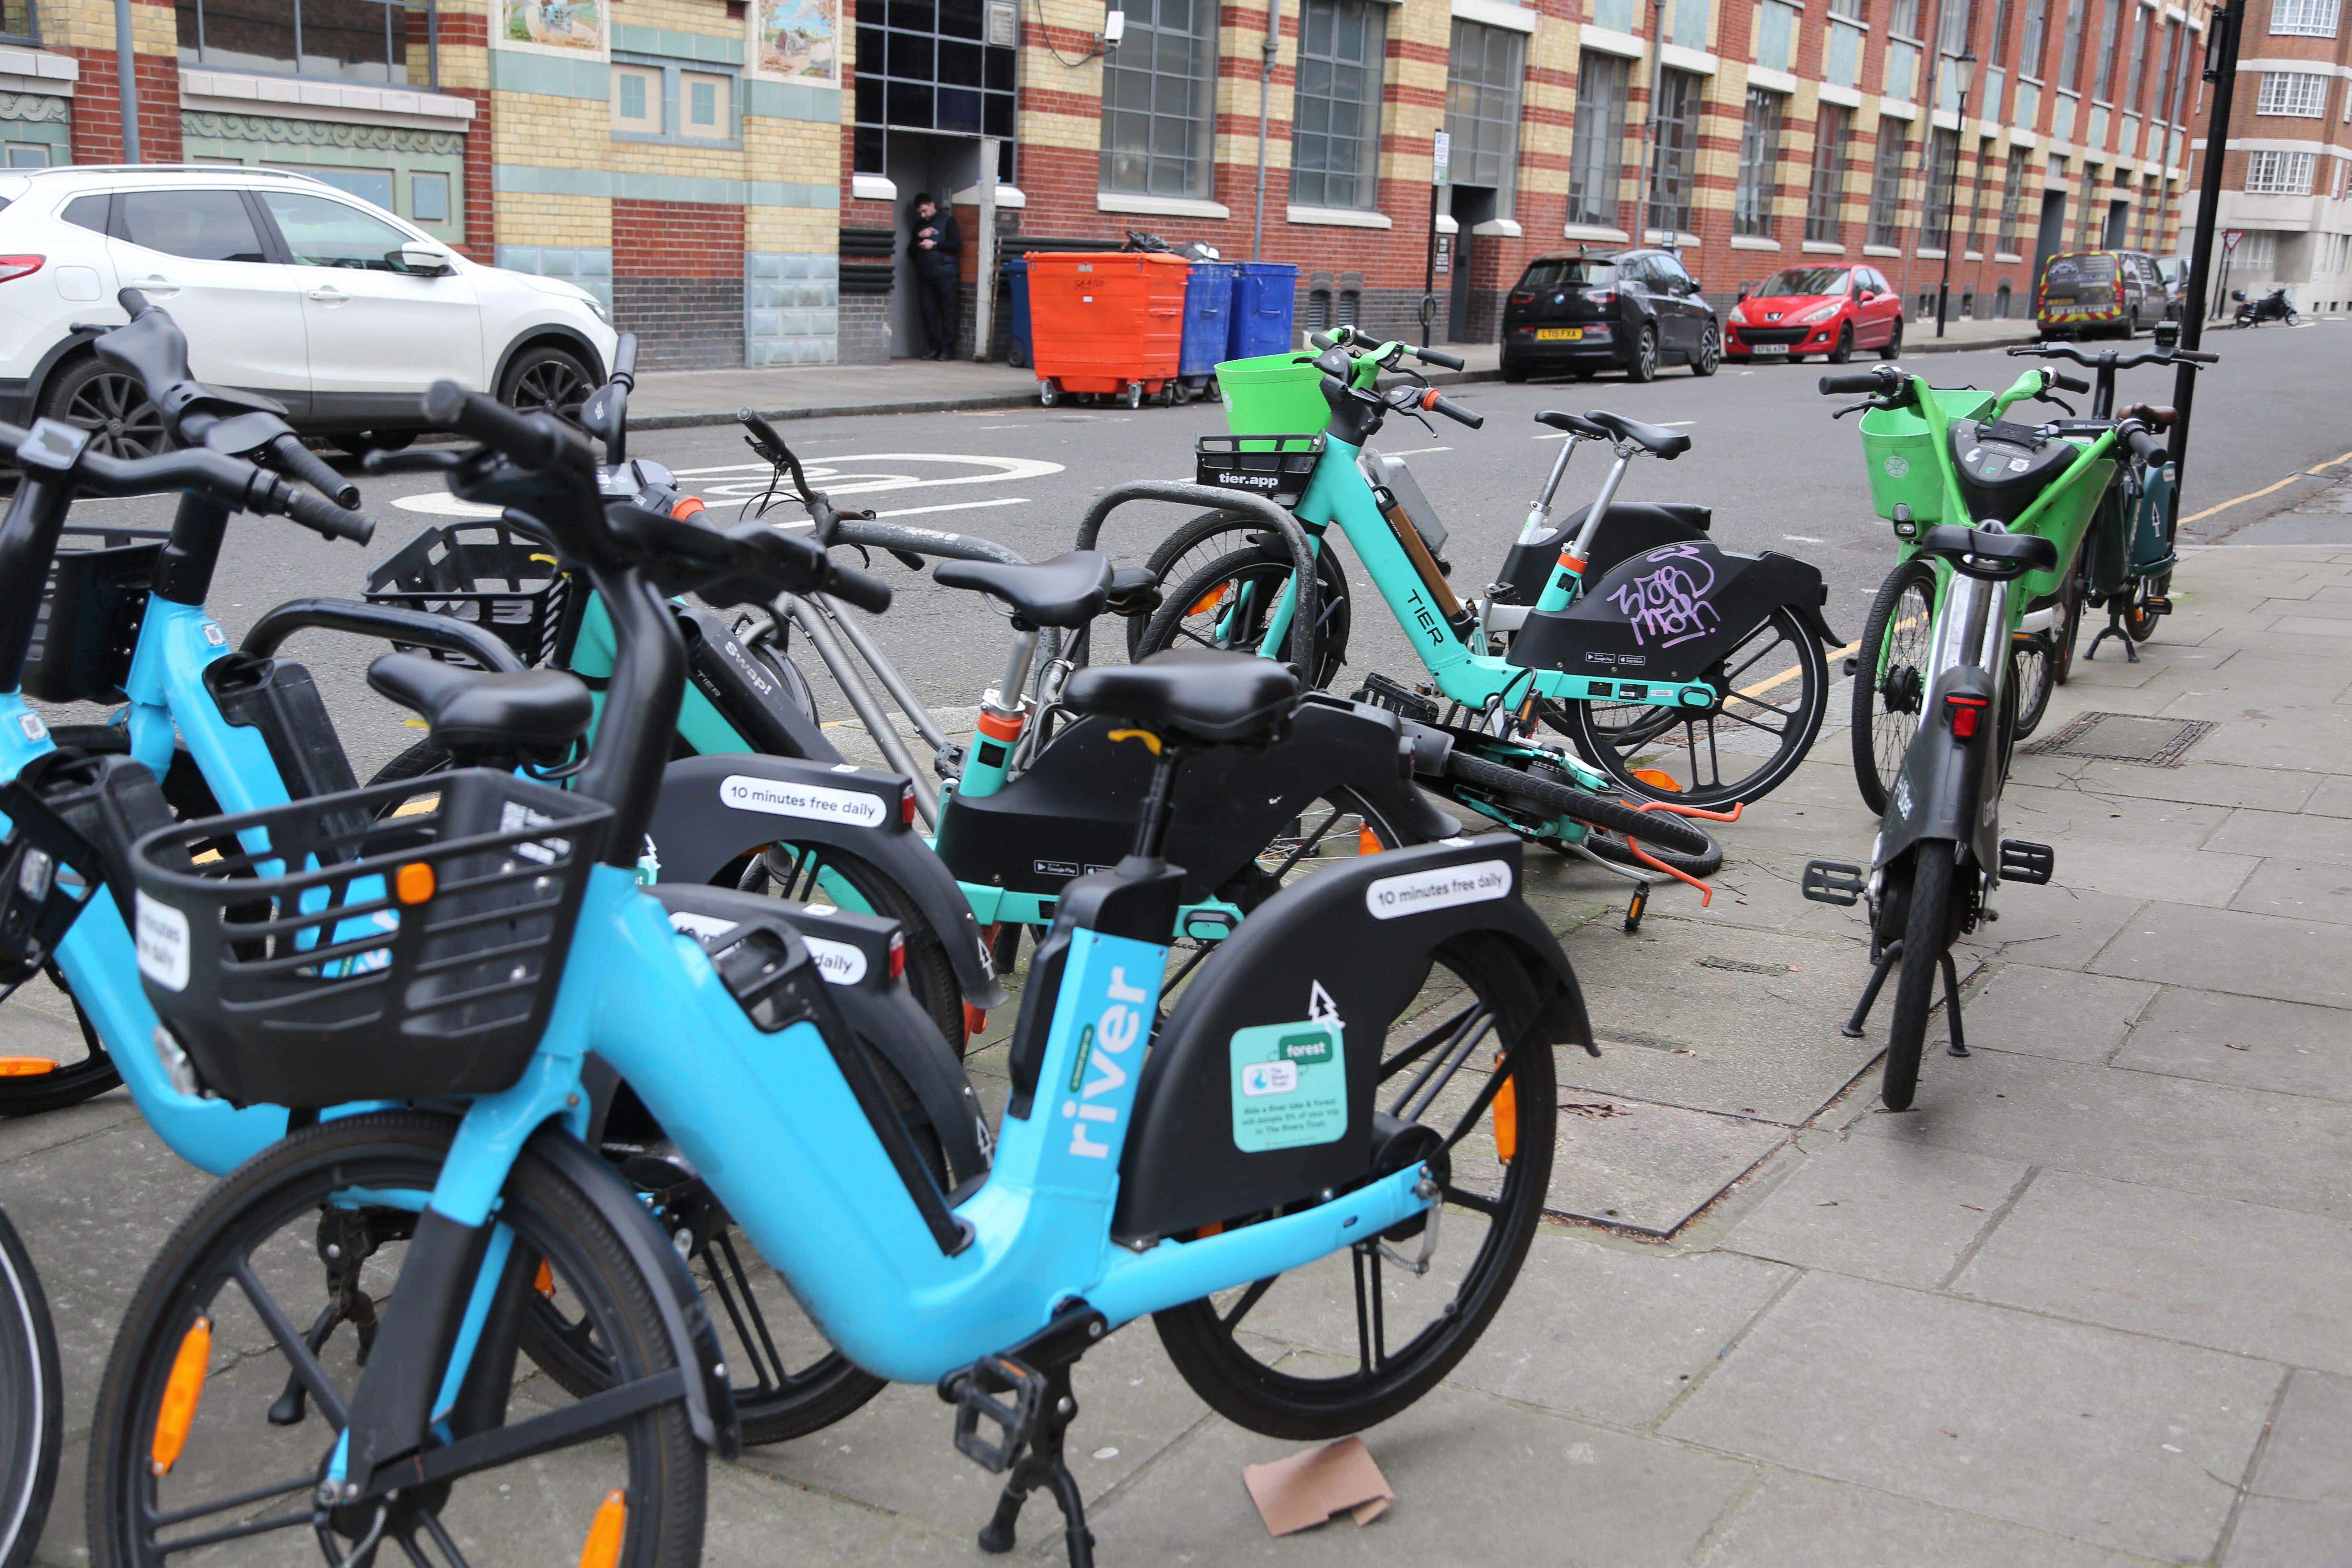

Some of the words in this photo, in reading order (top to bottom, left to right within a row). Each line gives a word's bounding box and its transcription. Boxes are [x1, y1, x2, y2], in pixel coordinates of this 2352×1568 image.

[1219, 472, 1278, 488] tier.app
[1408, 588, 1444, 647] TIER
[697, 669, 721, 697] TIER
[725, 641, 772, 695] Swap!
[731, 786, 748, 798] 10
[752, 790, 805, 807] minutes
[810, 797, 837, 811] free
[842, 802, 876, 819] daily
[1379, 891, 1395, 905] 10
[1399, 884, 1449, 902] minutes
[1452, 878, 1475, 893] free
[1478, 872, 1503, 889] daily
[813, 953, 853, 976] daily
[1062, 965, 1147, 1159] river
[1286, 1041, 1326, 1058] forest
